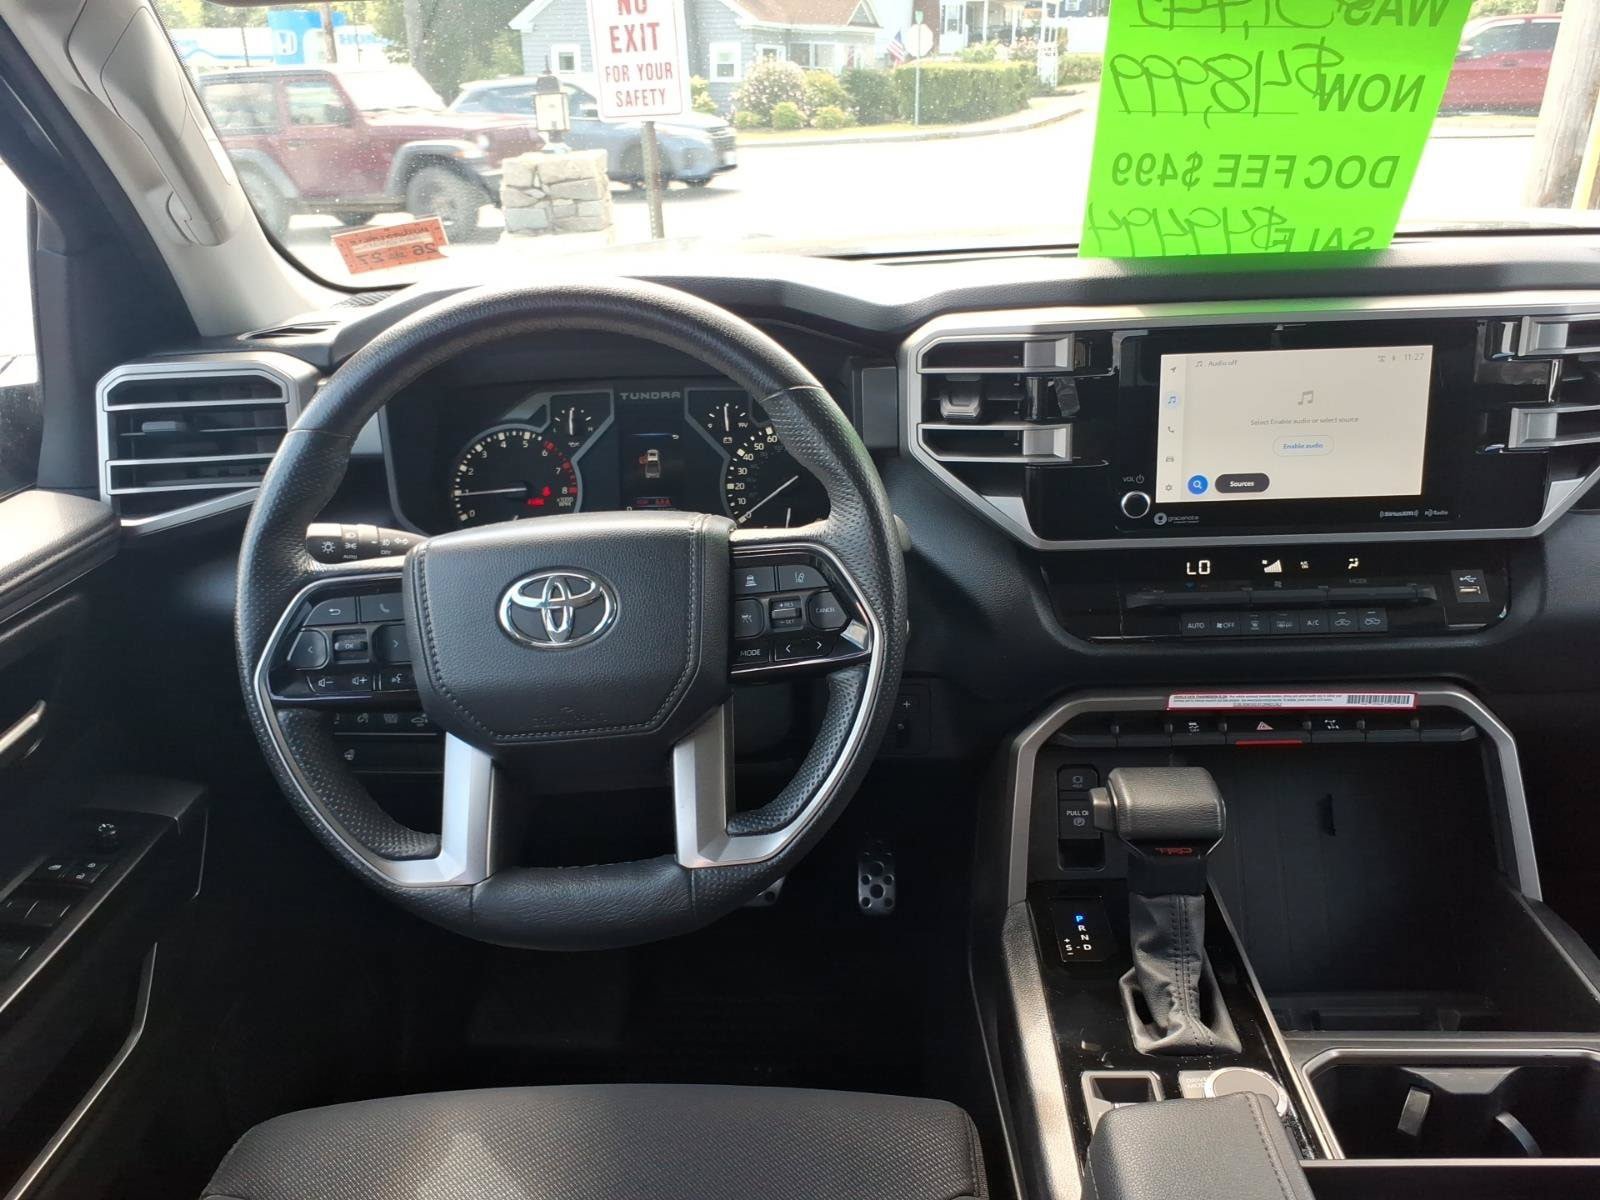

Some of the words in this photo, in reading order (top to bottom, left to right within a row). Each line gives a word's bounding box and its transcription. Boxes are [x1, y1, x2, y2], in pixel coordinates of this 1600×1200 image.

[609, 22, 660, 54] EXIT
[605, 65, 630, 83] FOR
[637, 62, 673, 80] YOUR
[616, 88, 666, 107] SAFETY
[1404, 352, 1425, 361] 11:27
[620, 391, 681, 400] TUNDRA
[1250, 418, 1269, 426] Select
[767, 435, 778, 443] 60
[522, 440, 529, 448] 5
[753, 443, 764, 451] 50
[742, 453, 754, 461] 40
[555, 467, 561, 475] 7
[737, 467, 748, 475] 30
[734, 482, 745, 490] 20
[561, 486, 568, 495] 8
[737, 497, 746, 505] 10
[468, 509, 476, 518] 0
[1186, 560, 1211, 575] LO
[1187, 622, 1205, 630] AUTO
[1222, 621, 1235, 629] OFF
[1306, 619, 1320, 627] A/C
[740, 648, 761, 657] MODE
[1075, 915, 1084, 923] P
[1078, 924, 1087, 932] R
